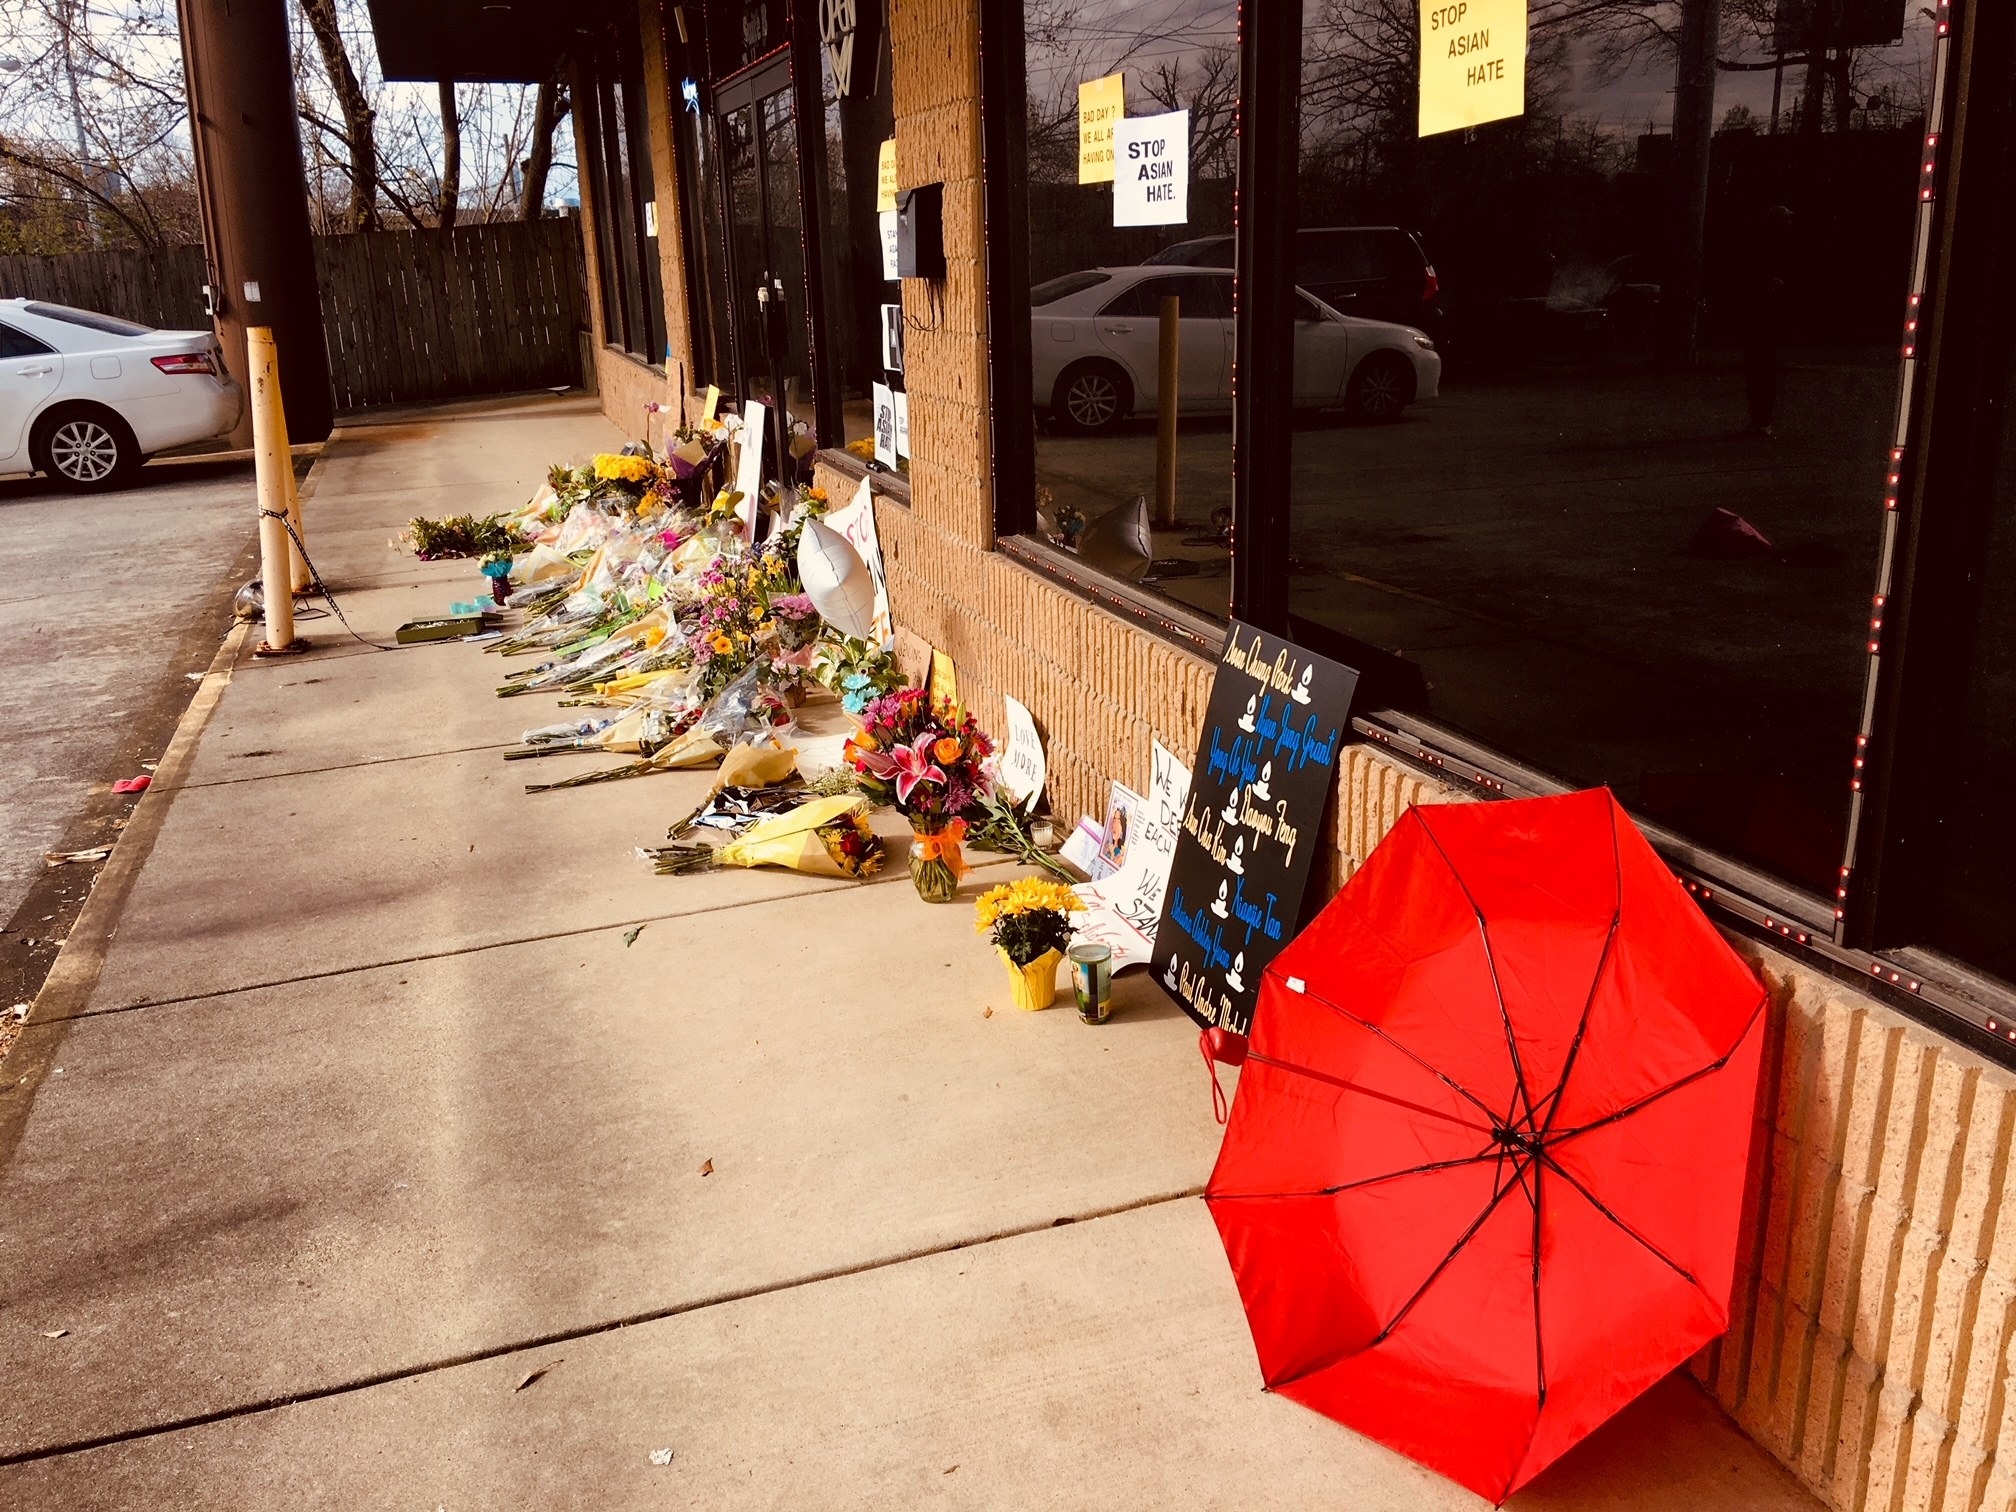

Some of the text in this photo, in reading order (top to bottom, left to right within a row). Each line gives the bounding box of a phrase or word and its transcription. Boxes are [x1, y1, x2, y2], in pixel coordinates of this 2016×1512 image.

[1431, 2, 1467, 31] STOP
[1448, 28, 1489, 59] ASIAN
[1467, 58, 1504, 87] HATE
[1083, 110, 1095, 124] BAD
[1096, 108, 1109, 121] DAY
[1083, 131, 1092, 144] WE
[1093, 130, 1105, 142] ALL
[1128, 139, 1166, 160] STOP
[1082, 150, 1104, 165] HAVING
[1138, 160, 1173, 181] ASIAN
[1146, 183, 1176, 203] HATE.
[887, 229, 898, 240] STA
[1270, 648, 1297, 695] Park
[1014, 724, 1036, 750] LOVE
[1274, 703, 1301, 772] Jung
[1299, 714, 1336, 769] Grant
[1011, 749, 1038, 782] MORE
[1154, 748, 1172, 798] WE
[1144, 822, 1172, 857] EACH
[1238, 783, 1298, 868] Daoyou Feng
[1210, 819, 1227, 866] Kim
[1137, 867, 1162, 902] WE
[1114, 897, 1160, 942] STAN
[1230, 875, 1282, 946] Xiaojie Tan
[1179, 960, 1197, 1004] Paul
[1193, 975, 1217, 1025] Andre
